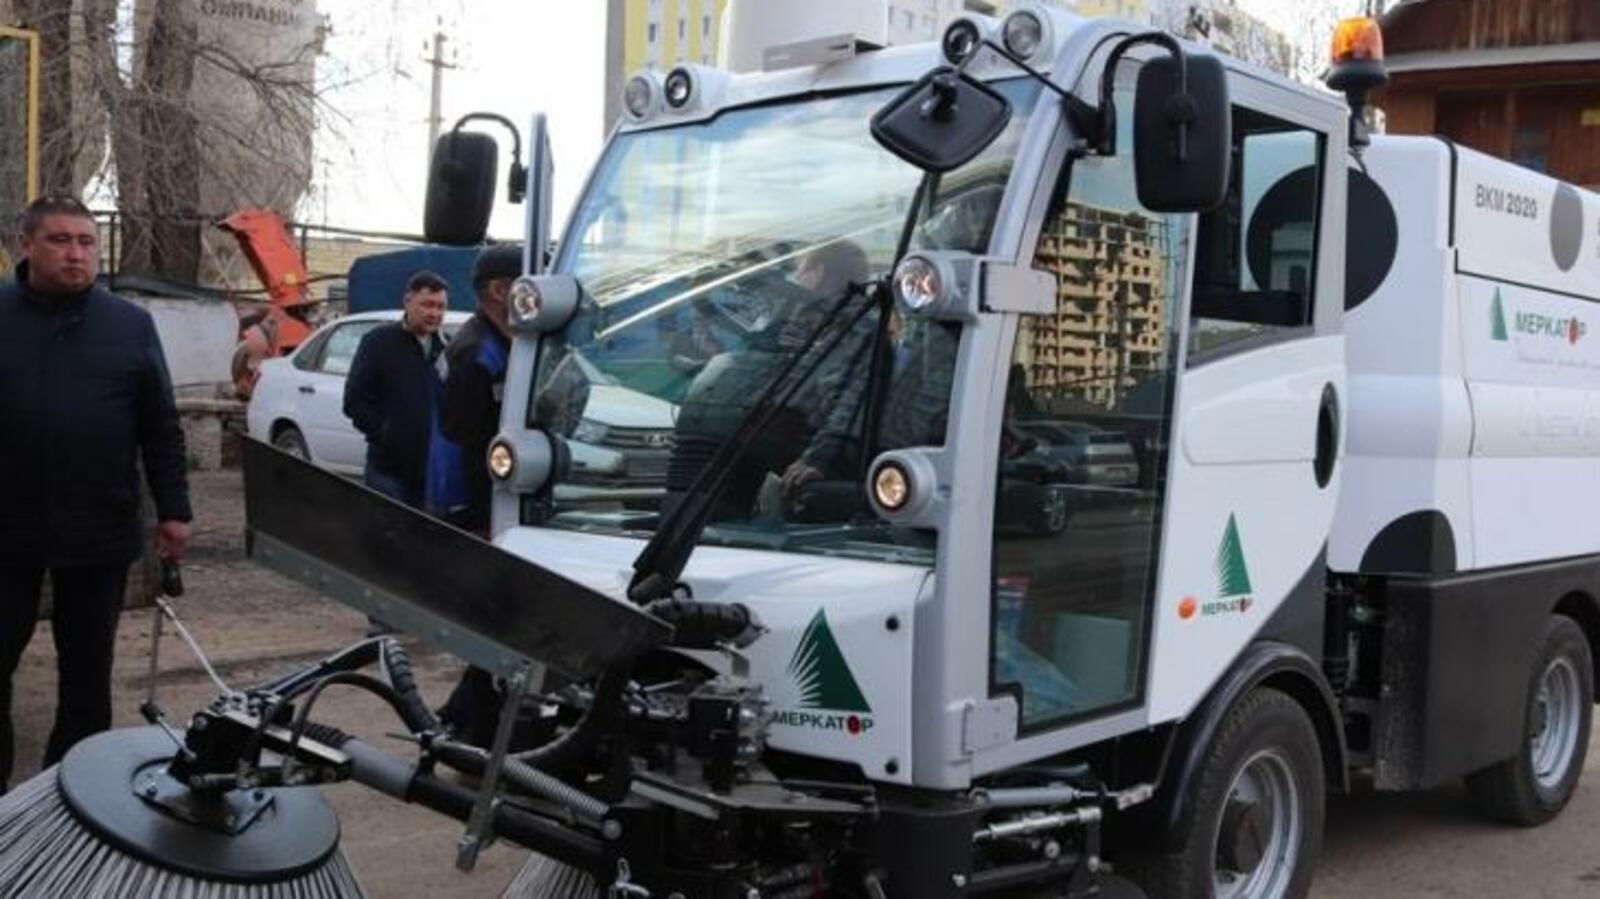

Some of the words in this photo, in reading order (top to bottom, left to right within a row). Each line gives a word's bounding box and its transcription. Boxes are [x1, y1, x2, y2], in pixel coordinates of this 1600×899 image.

[1506, 192, 1538, 219] 2020
[1515, 311, 1587, 345] МЕРКАТОР
[772, 710, 874, 734] МЕРКАТОР
